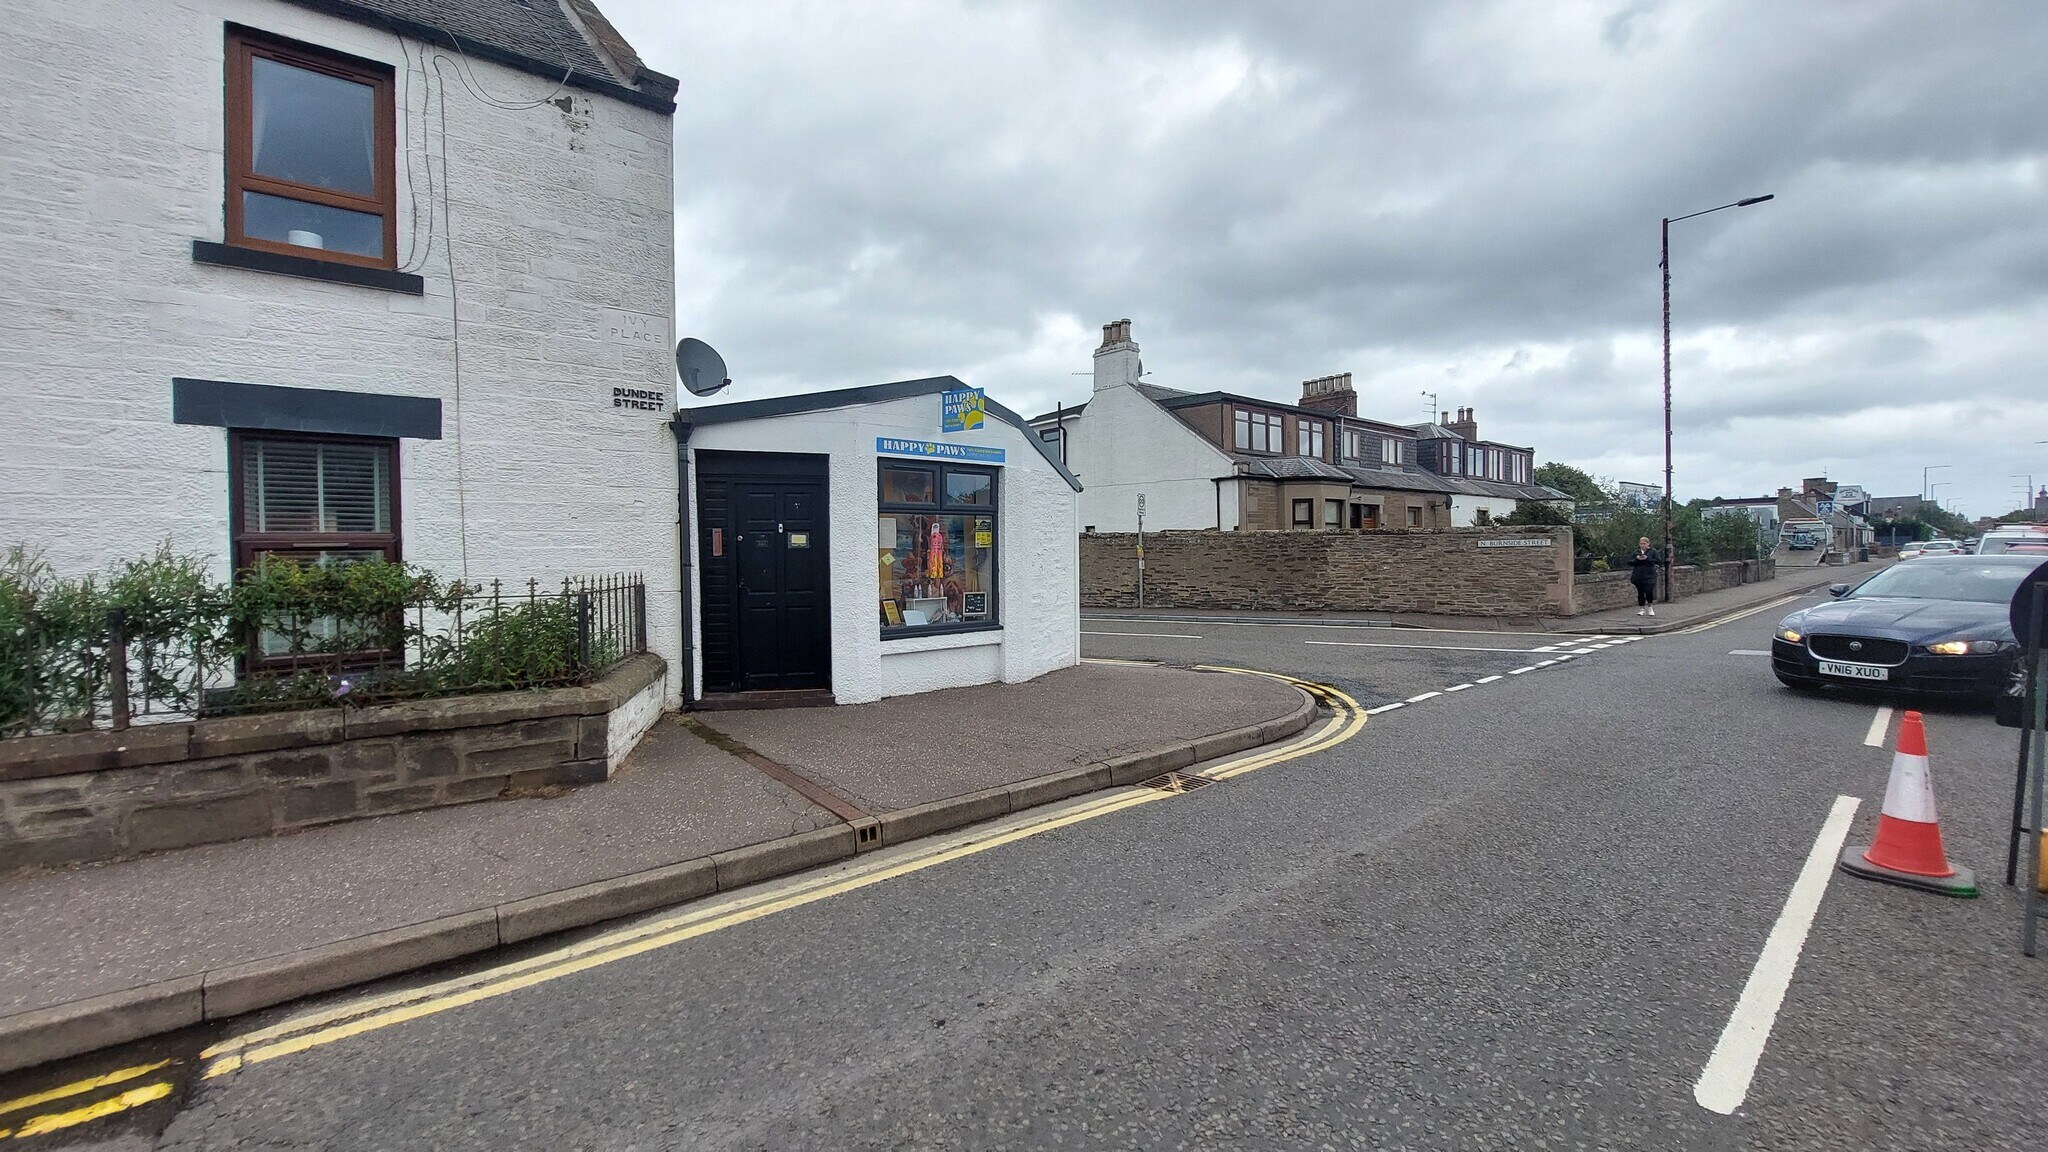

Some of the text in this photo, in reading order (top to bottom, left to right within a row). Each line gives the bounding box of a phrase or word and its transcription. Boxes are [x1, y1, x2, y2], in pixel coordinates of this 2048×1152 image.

[623, 316, 649, 327] IVY
[611, 328, 661, 343] PLACE
[613, 387, 664, 401] DUNDEE
[945, 391, 979, 404] HAPPY
[613, 398, 664, 411] STREET
[945, 403, 972, 414] PAWS
[883, 440, 925, 453] HAPPY
[936, 444, 966, 457] PAWS
[1827, 664, 1880, 678] VN16 XUO
